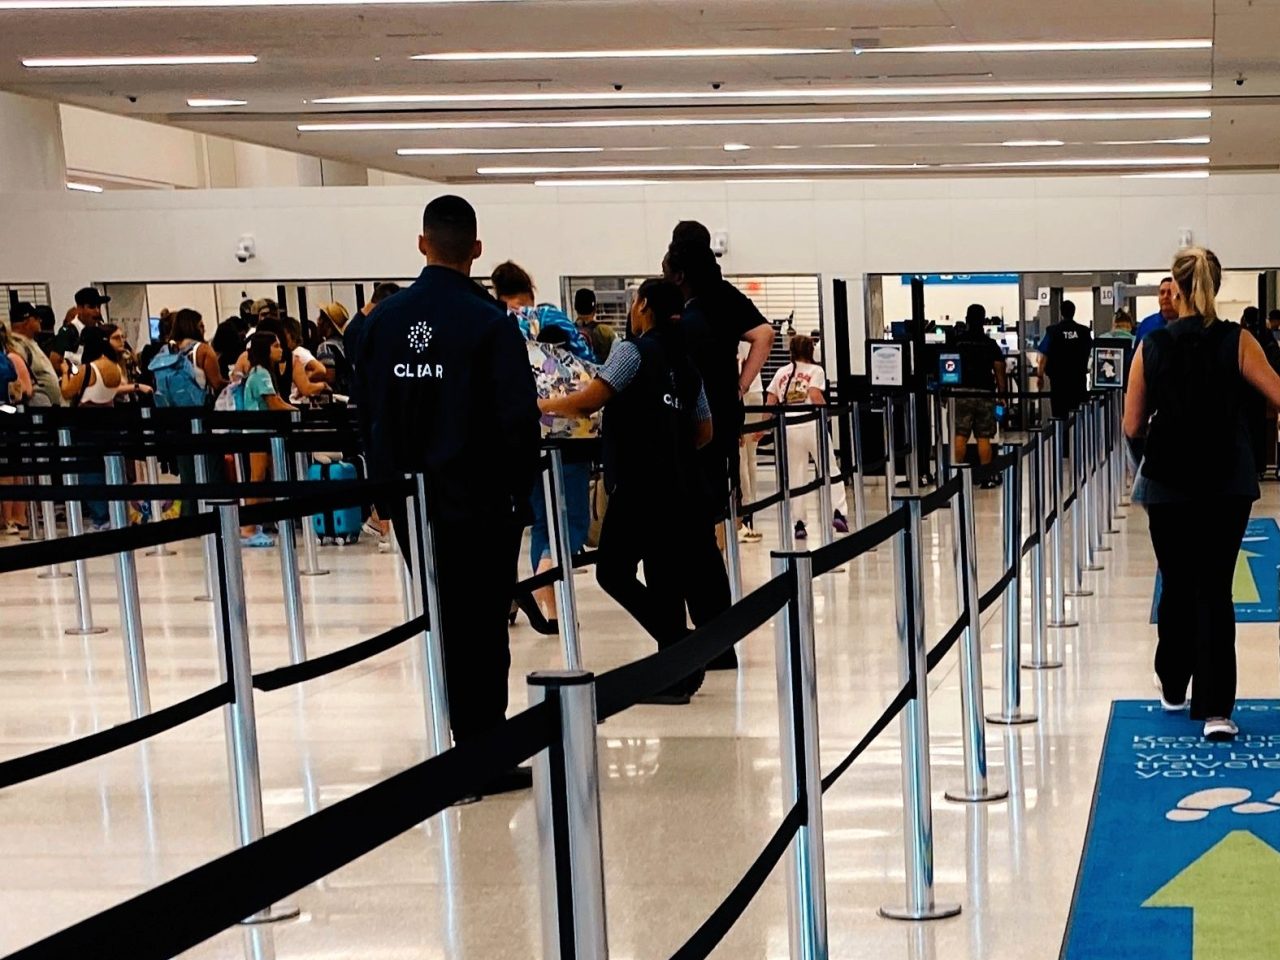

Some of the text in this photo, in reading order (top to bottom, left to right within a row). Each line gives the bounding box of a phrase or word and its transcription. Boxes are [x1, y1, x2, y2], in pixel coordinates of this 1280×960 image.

[1102, 290, 1113, 300] 10
[1063, 331, 1079, 339] TSA
[393, 363, 445, 379] CLEAR
[1133, 735, 1206, 743] Kee
